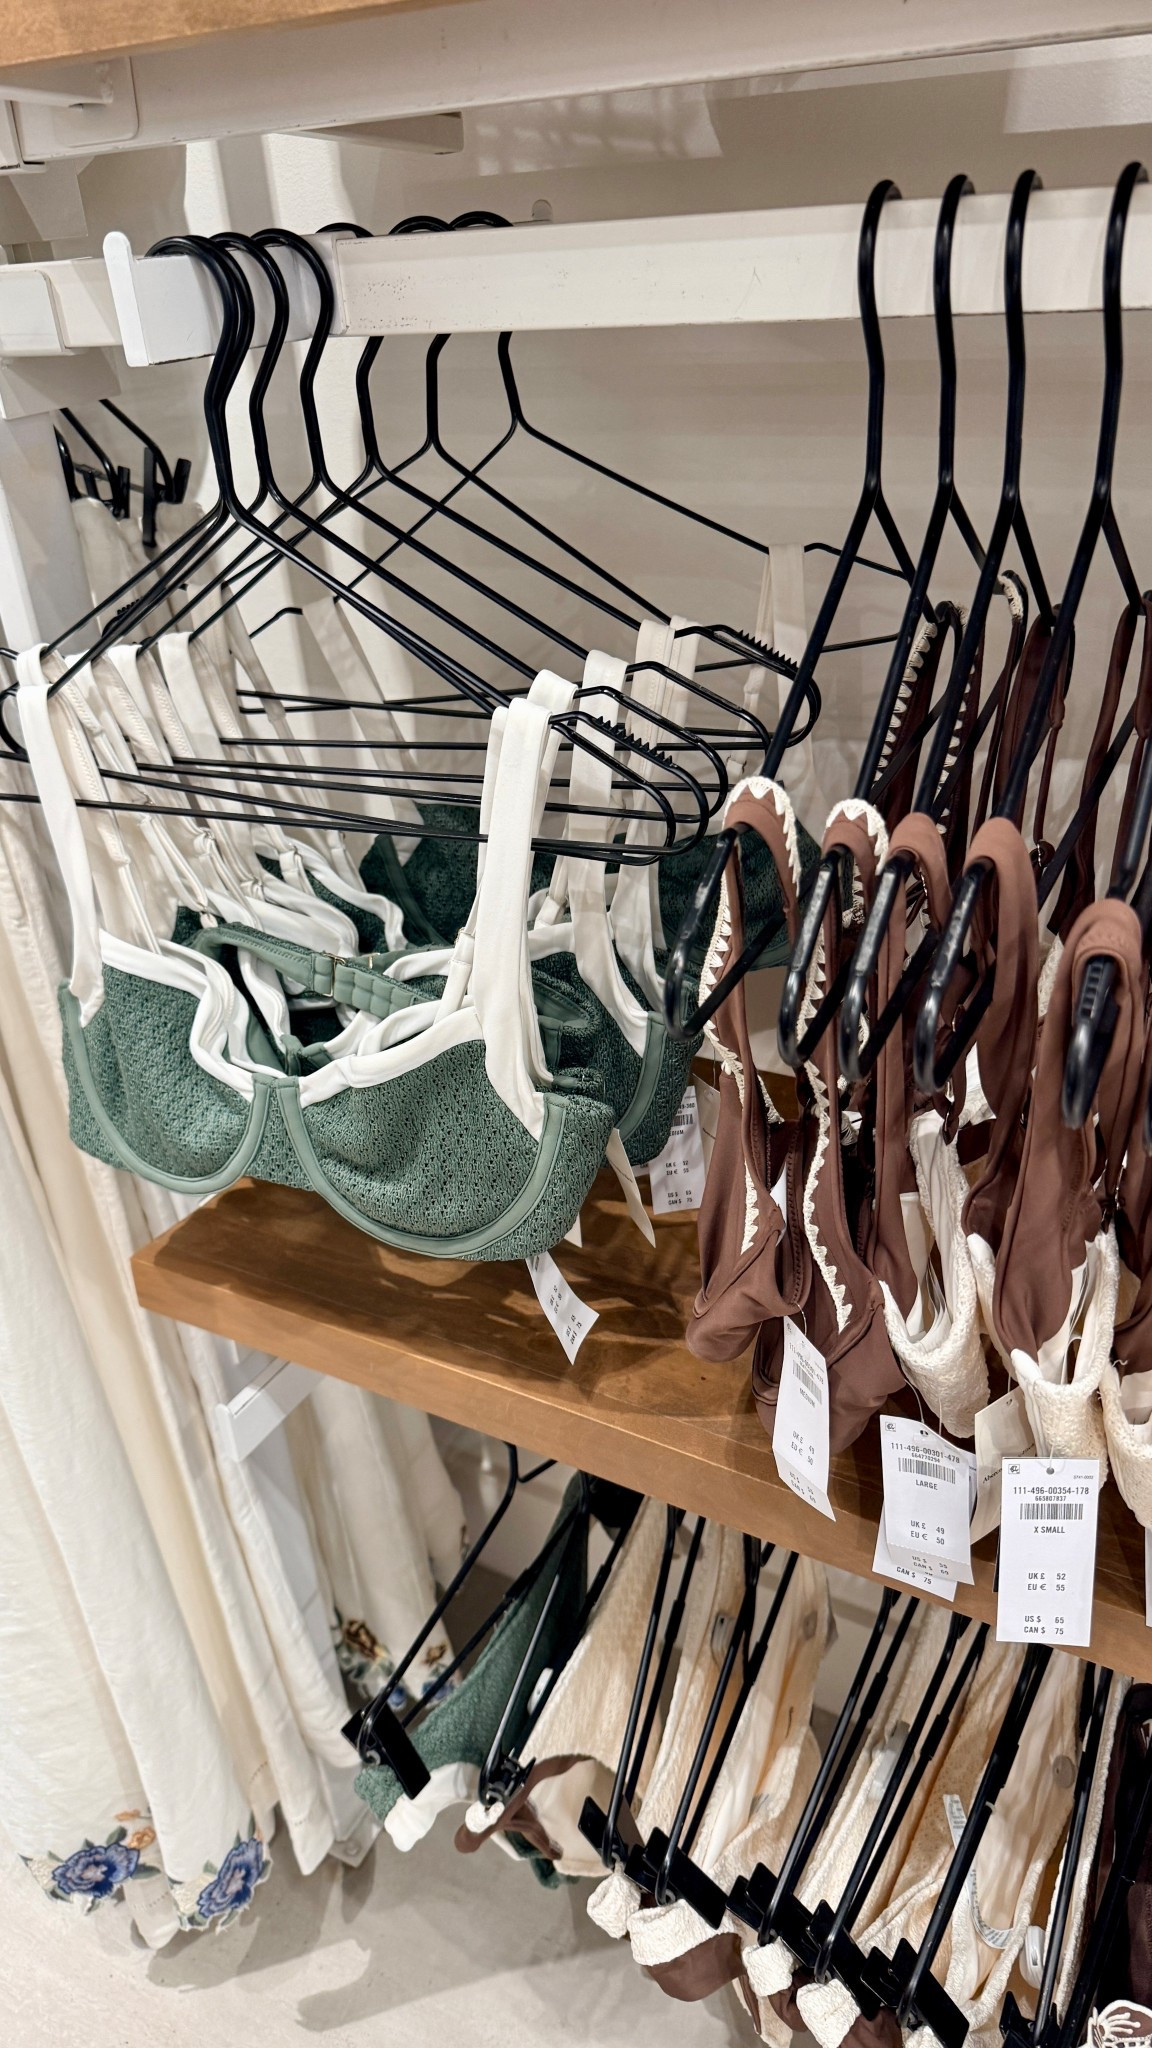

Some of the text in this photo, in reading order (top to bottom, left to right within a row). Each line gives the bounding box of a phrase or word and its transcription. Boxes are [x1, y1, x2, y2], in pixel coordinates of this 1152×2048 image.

[891, 1442, 960, 1464] 111-496-00301-478
[915, 1479, 938, 1490] LARGE
[1014, 1486, 1090, 1494] 111-496-00354-178
[910, 1520, 920, 1528] UK
[936, 1526, 945, 1534] 49
[910, 1530, 920, 1538] EU
[936, 1537, 944, 1545] 50
[896, 1566, 910, 1576] CAN
[924, 1576, 932, 1584] 75
